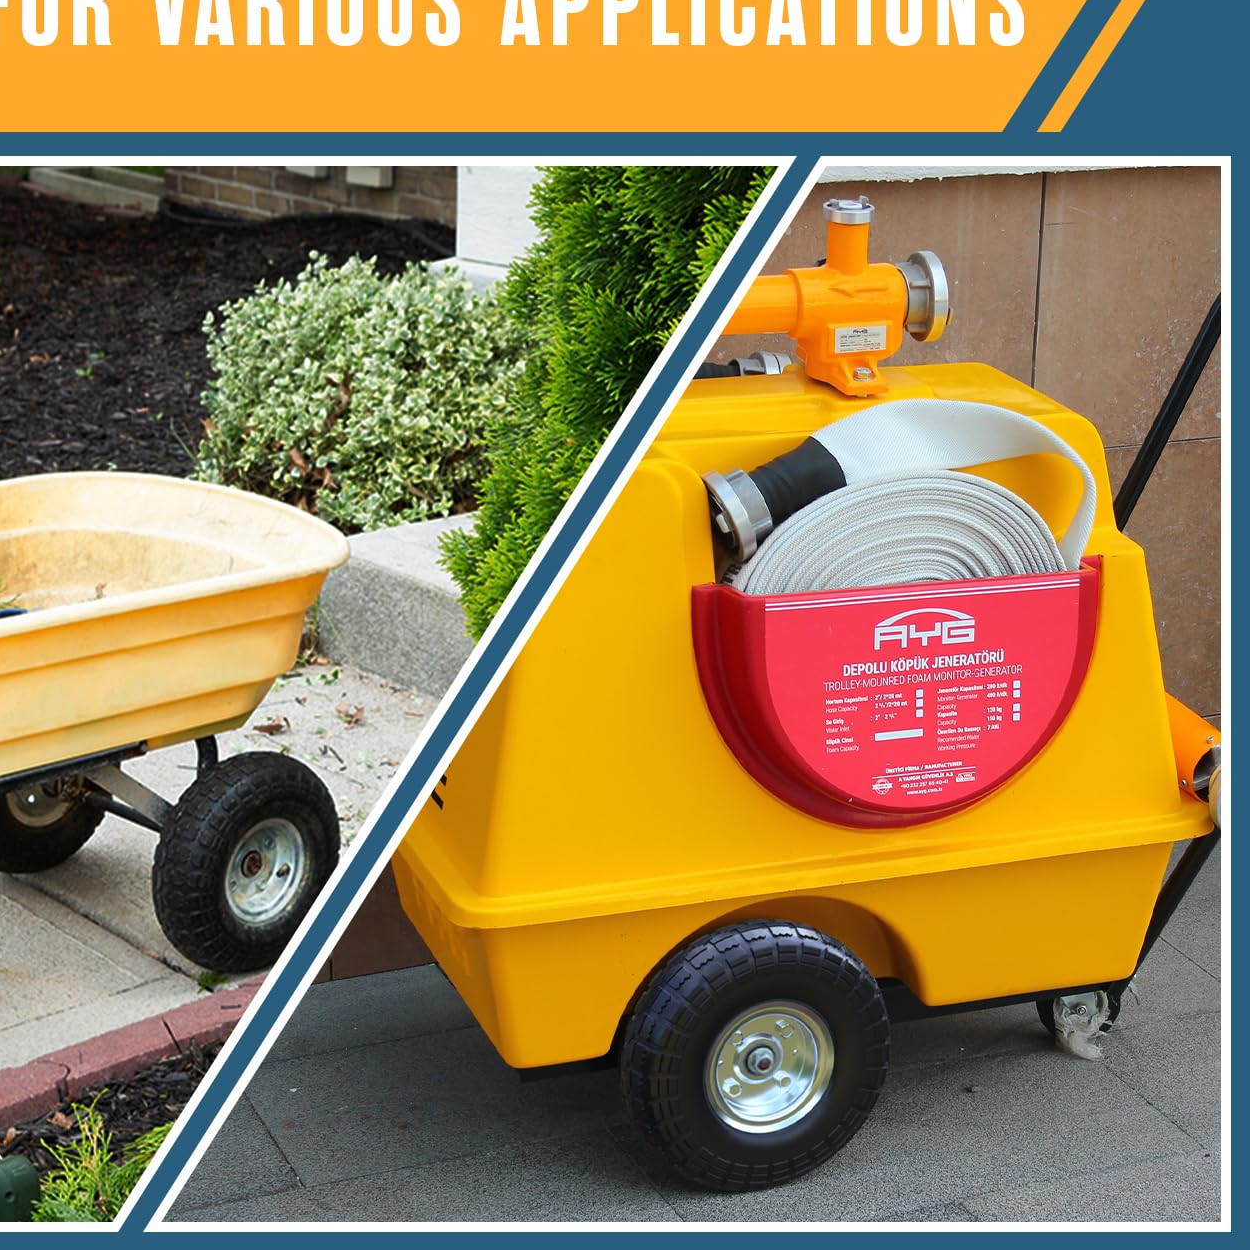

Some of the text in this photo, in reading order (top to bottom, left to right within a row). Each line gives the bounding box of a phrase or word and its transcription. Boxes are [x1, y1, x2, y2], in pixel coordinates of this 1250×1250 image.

[874, 618, 975, 650] AYG
[843, 648, 1005, 677] DEPOLU KÖPÜK JENERATÖRÜ
[824, 664, 1023, 692] TROLLEY-MOUNRED FOAM MONITOR-GENERATOR
